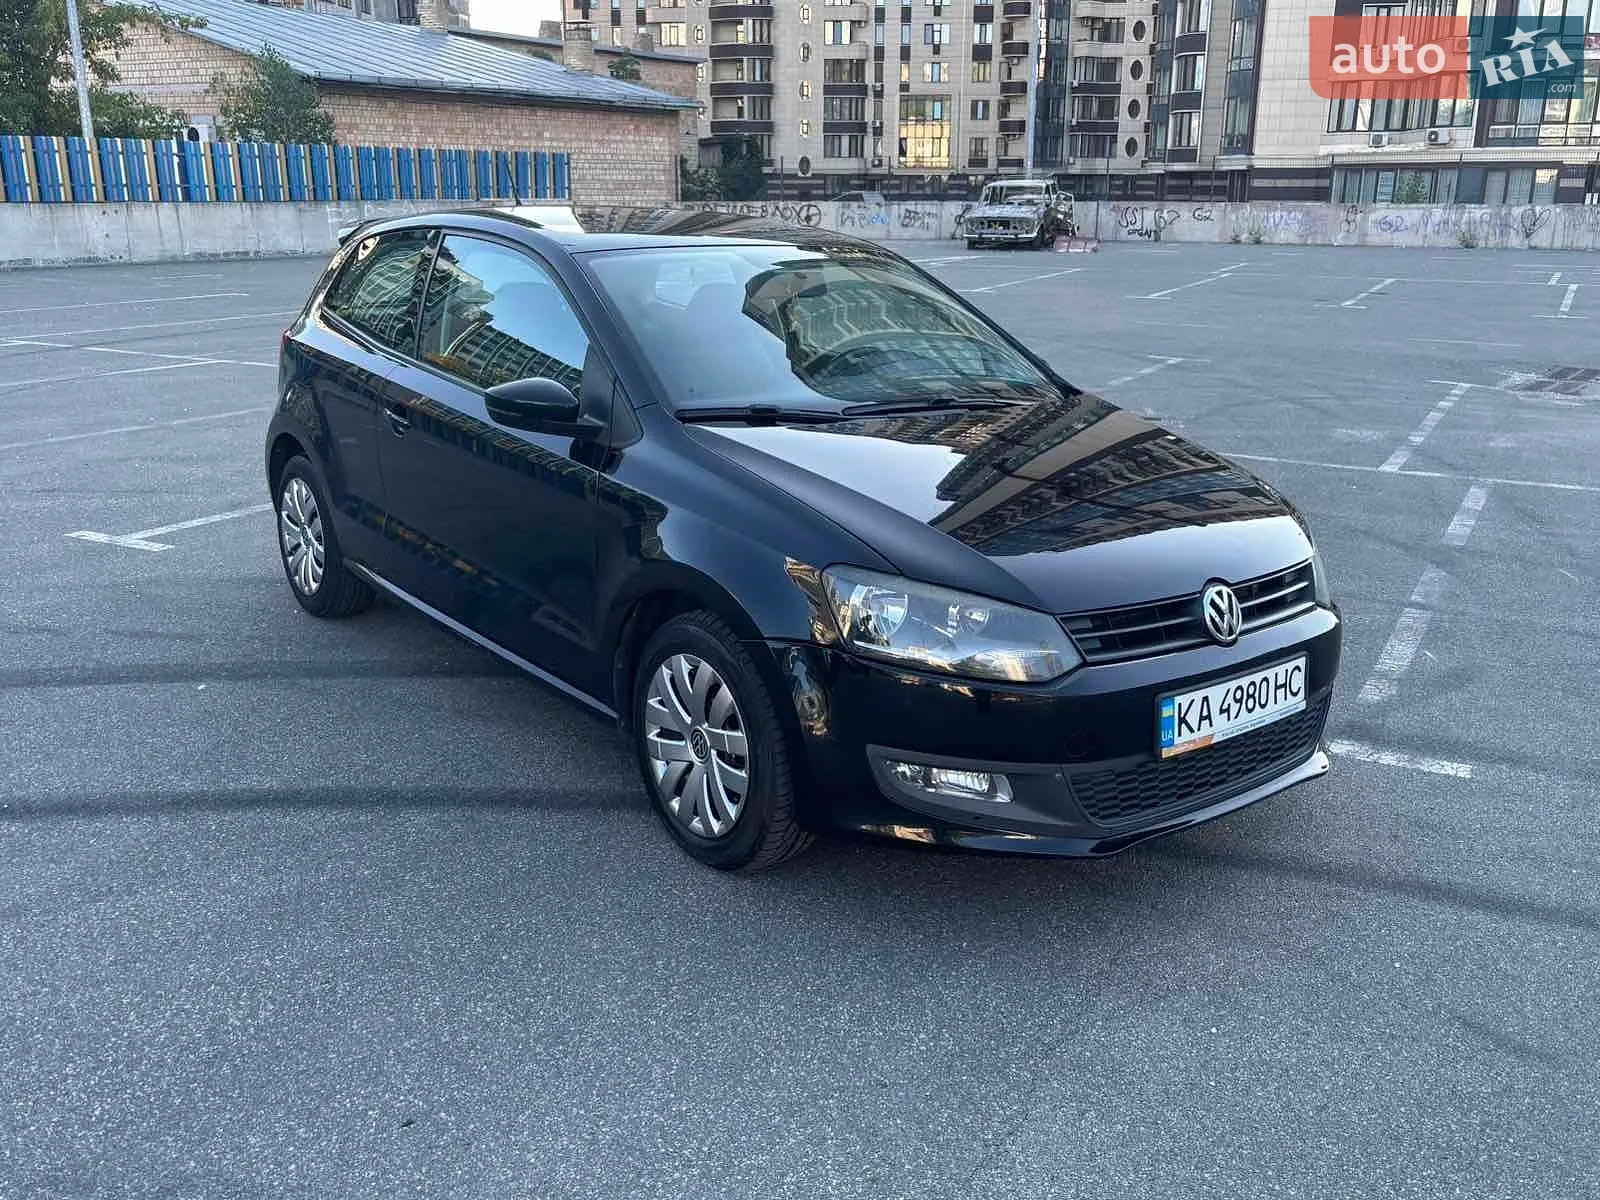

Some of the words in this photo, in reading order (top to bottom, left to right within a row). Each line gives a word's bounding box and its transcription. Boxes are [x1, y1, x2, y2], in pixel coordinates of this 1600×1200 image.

[1177, 695, 1213, 737] KA
[1219, 676, 1270, 722] 4980
[1274, 665, 1302, 705] HC
[1161, 729, 1174, 742] UA
